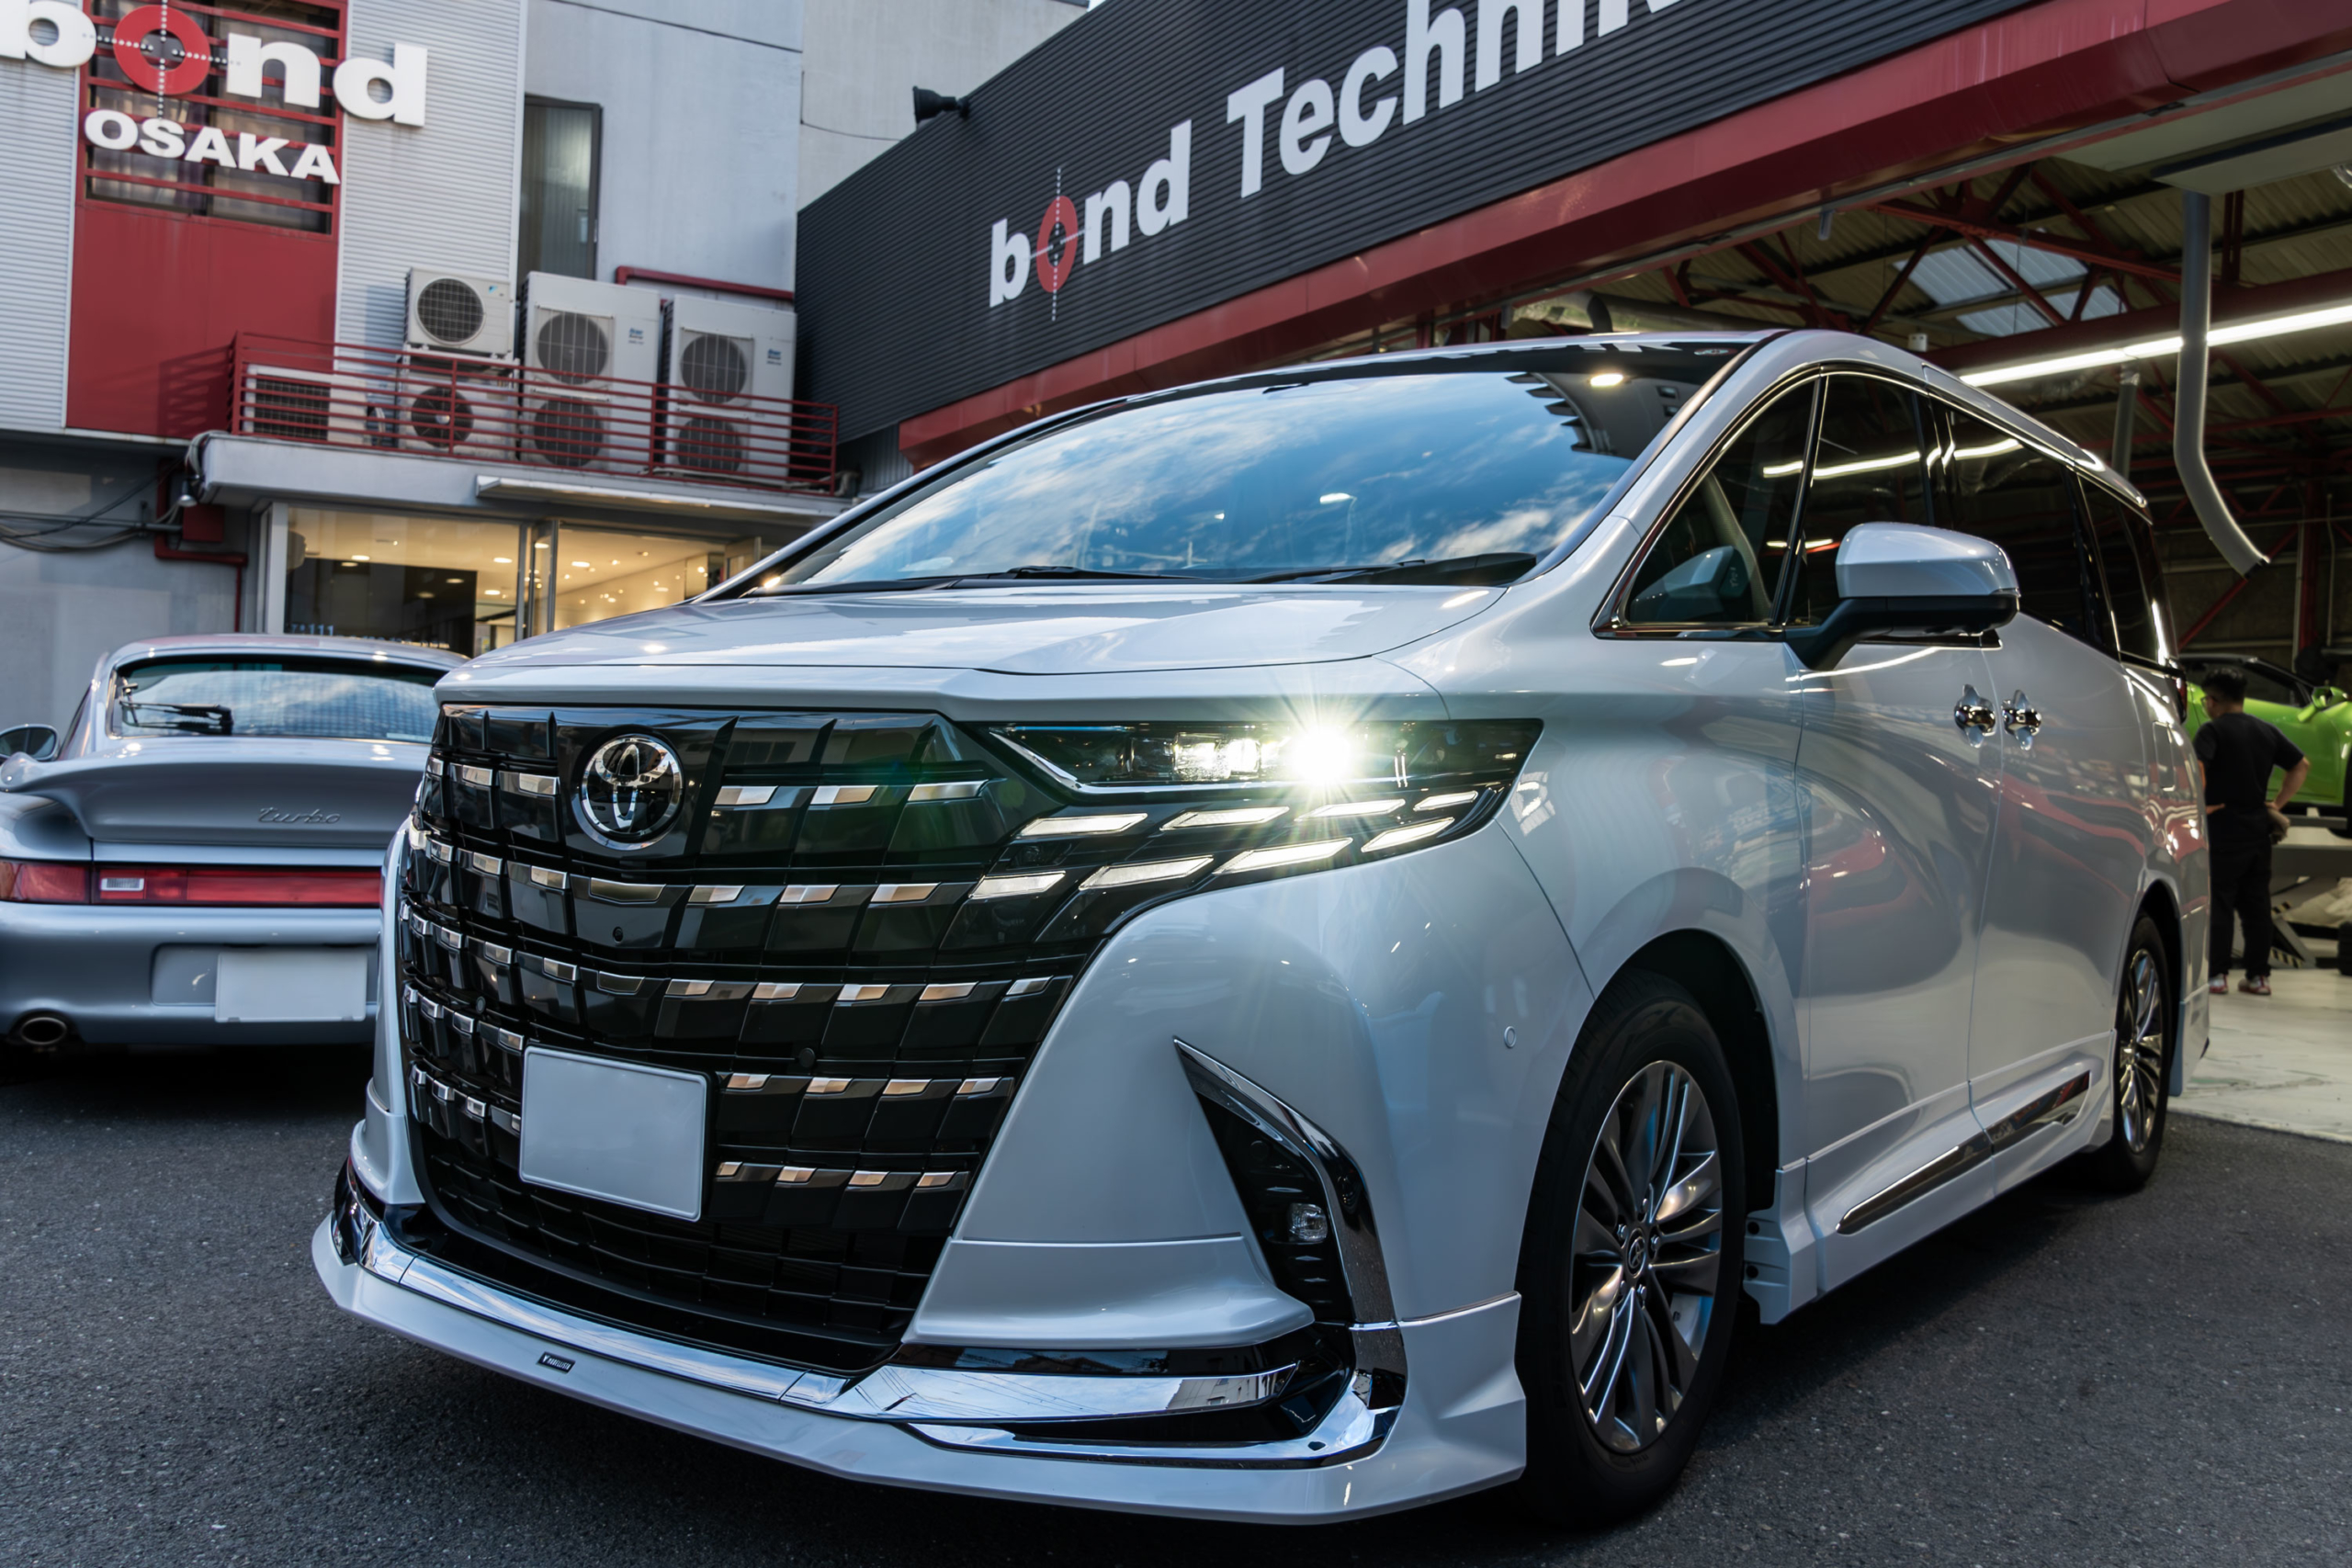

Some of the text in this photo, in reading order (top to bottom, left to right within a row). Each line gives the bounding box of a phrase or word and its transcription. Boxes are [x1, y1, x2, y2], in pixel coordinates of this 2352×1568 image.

[0, 0, 428, 127] bond
[84, 108, 341, 185] OSAKA
[989, 0, 1680, 308] bond Techn
[258, 807, 341, 824] turbo
